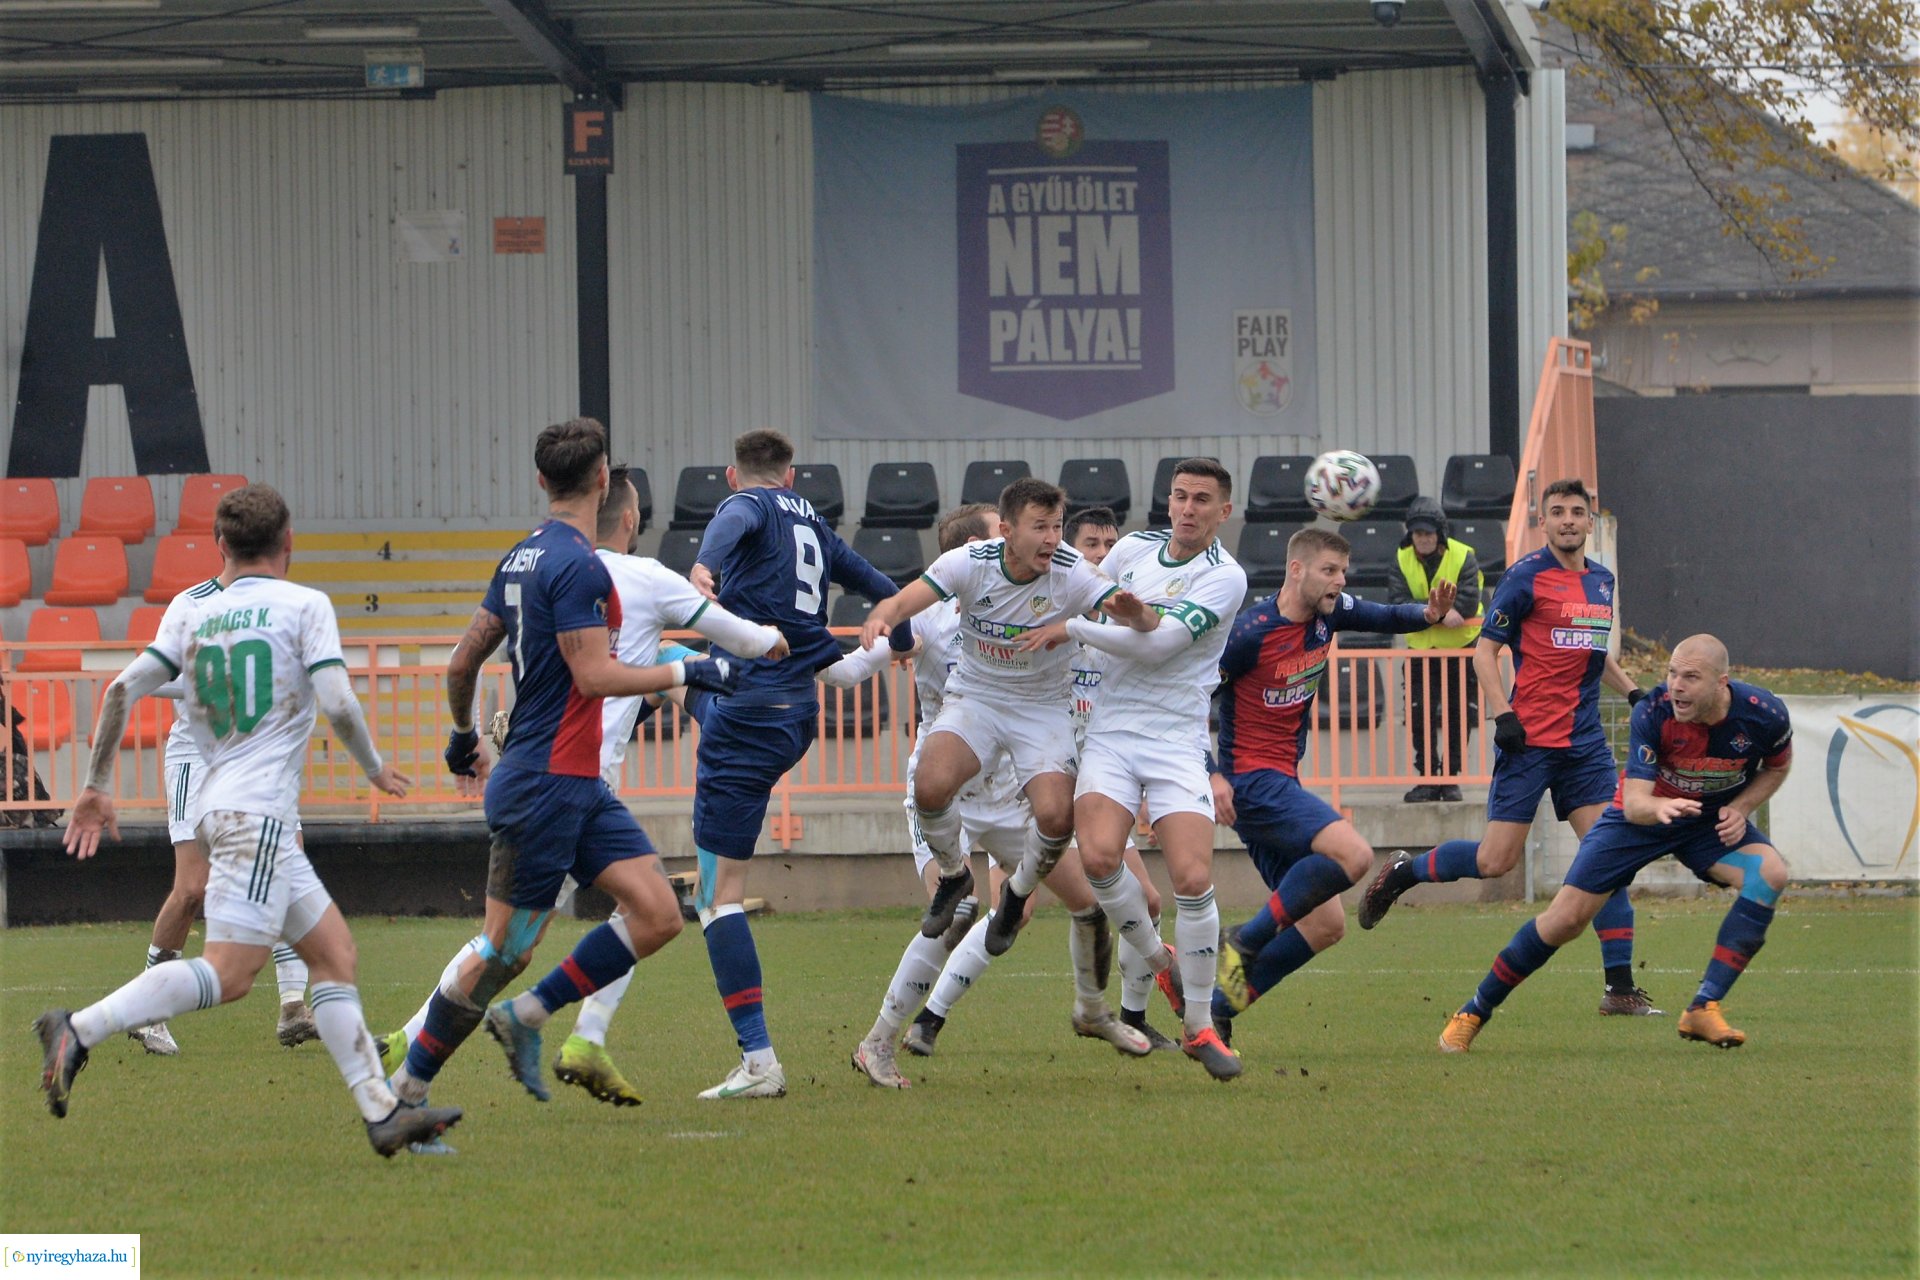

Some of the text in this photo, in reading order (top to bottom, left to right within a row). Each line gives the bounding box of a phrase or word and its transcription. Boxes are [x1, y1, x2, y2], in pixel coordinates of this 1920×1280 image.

[574, 111, 605, 153] F
[988, 175, 1137, 214] A GYŰLÖLET
[987, 214, 1141, 296] NEM
[7, 133, 211, 477] A
[989, 299, 1142, 362] PÁLYA!
[1237, 315, 1289, 336] FAIR
[1237, 337, 1288, 358] PLAY
[377, 541, 391, 561] 4
[793, 524, 824, 615] 9
[256, 607, 273, 628] K.
[365, 593, 379, 613] 3
[1184, 608, 1208, 633] C
[504, 583, 525, 682] 7
[979, 653, 1029, 667] automotive
[195, 639, 273, 740] 90
